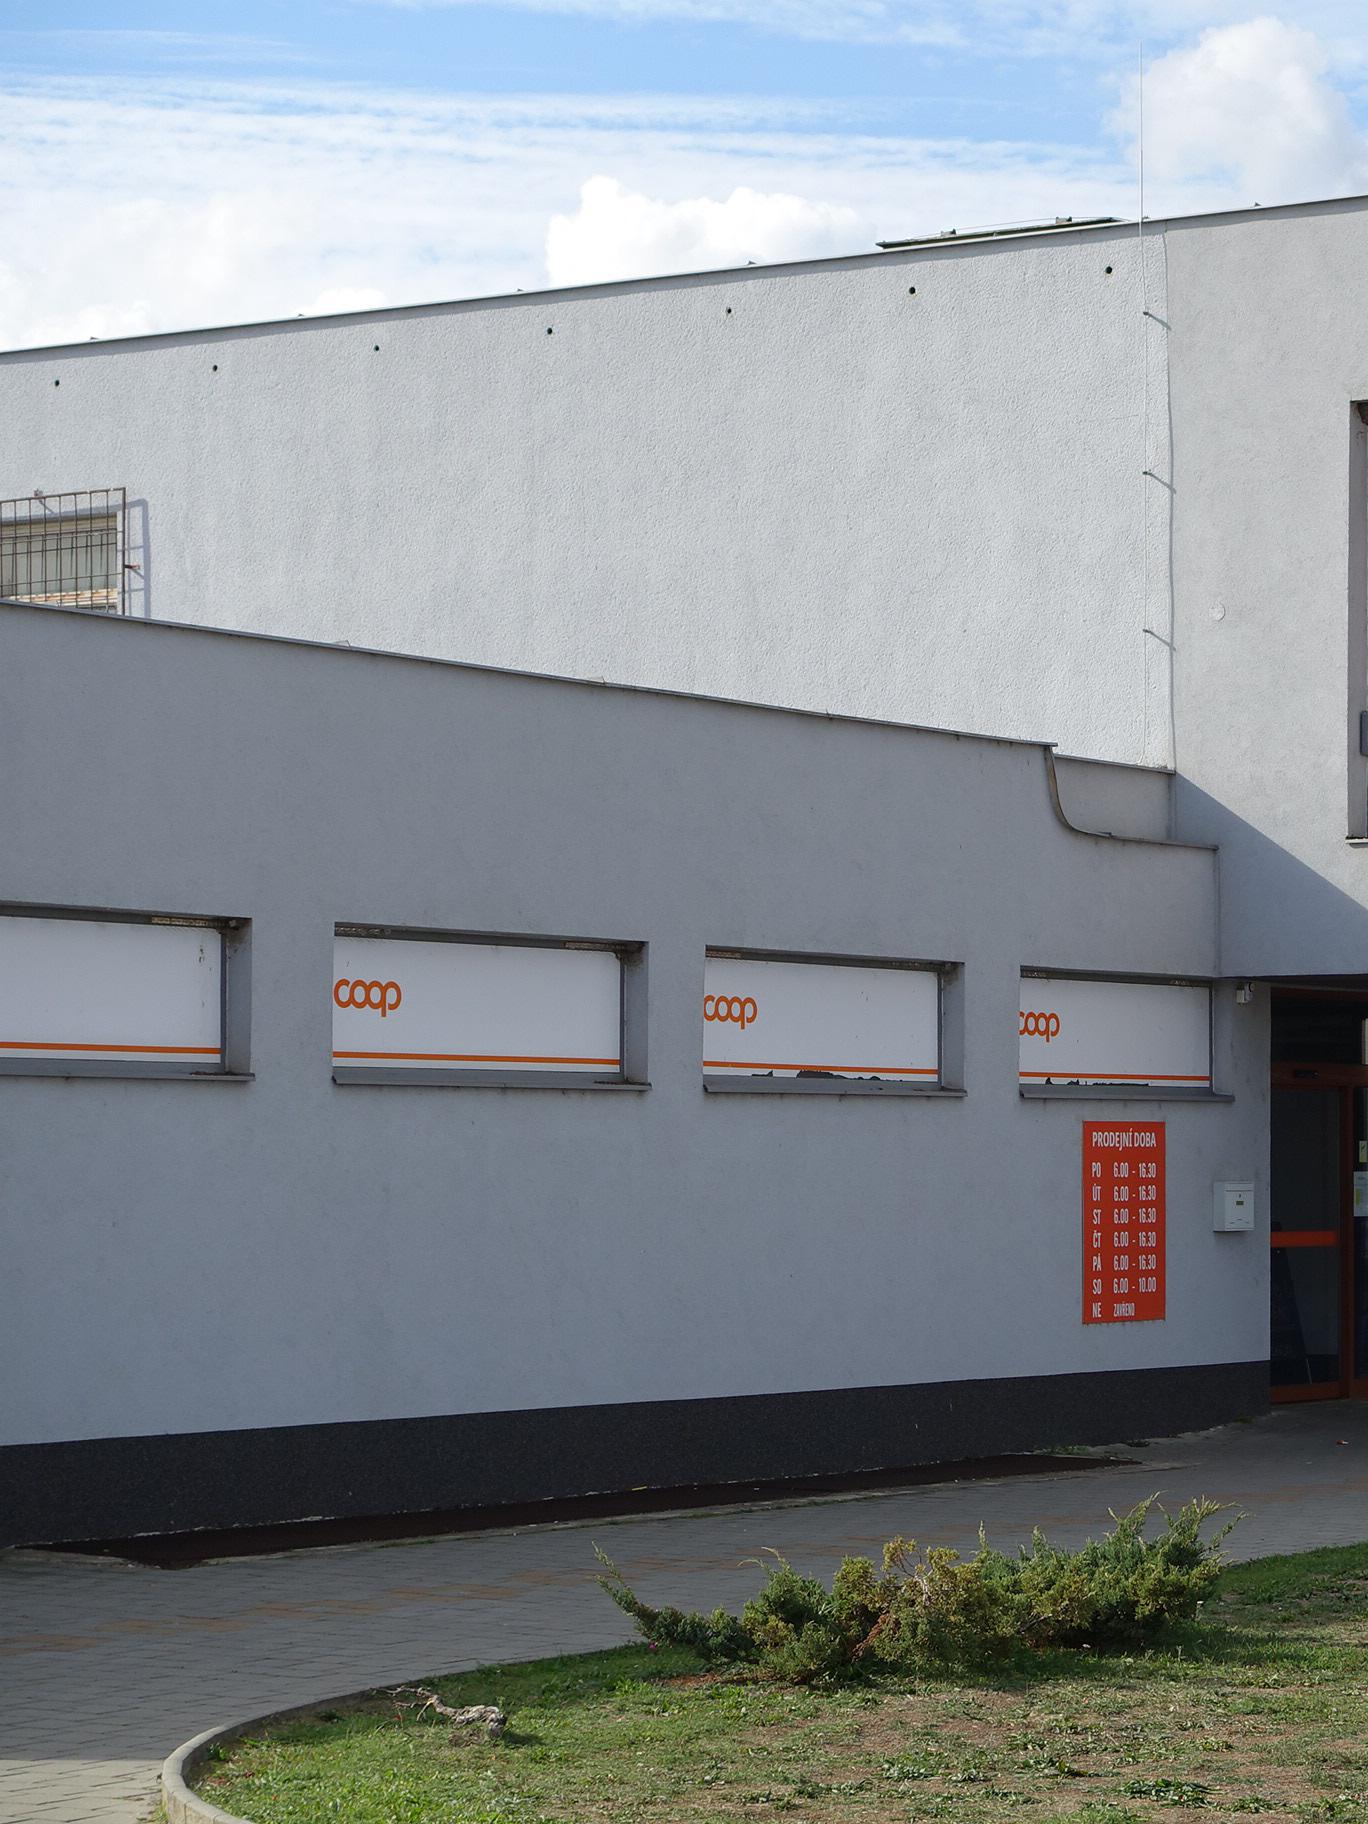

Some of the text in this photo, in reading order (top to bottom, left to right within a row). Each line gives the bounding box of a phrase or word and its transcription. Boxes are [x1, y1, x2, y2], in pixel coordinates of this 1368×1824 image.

[333, 978, 402, 1018] coop
[703, 994, 758, 1030] coop
[1092, 1128, 1156, 1151] PRODEJNÍ DOBA
[1092, 1162, 1102, 1178] PO
[1113, 1162, 1129, 1178] 6.00
[1139, 1162, 1157, 1178] 16.30
[1092, 1183, 1102, 1201] ÚT
[1113, 1186, 1129, 1201] 6.00
[1139, 1185, 1157, 1200] 16.30
[1092, 1208, 1102, 1225] ST
[1113, 1208, 1129, 1224] 6.00
[1139, 1208, 1157, 1224] 16.30
[1092, 1230, 1102, 1248] ČT
[1113, 1231, 1129, 1247] 6.00
[1139, 1231, 1157, 1247] 16.30
[1092, 1253, 1102, 1271] PÁ
[1113, 1255, 1129, 1271] 6.00
[1139, 1254, 1157, 1270] 16.30
[1092, 1279, 1102, 1295] SO
[1113, 1278, 1129, 1294] 6.00
[1139, 1277, 1157, 1293] 10.00
[1092, 1302, 1102, 1318] NE
